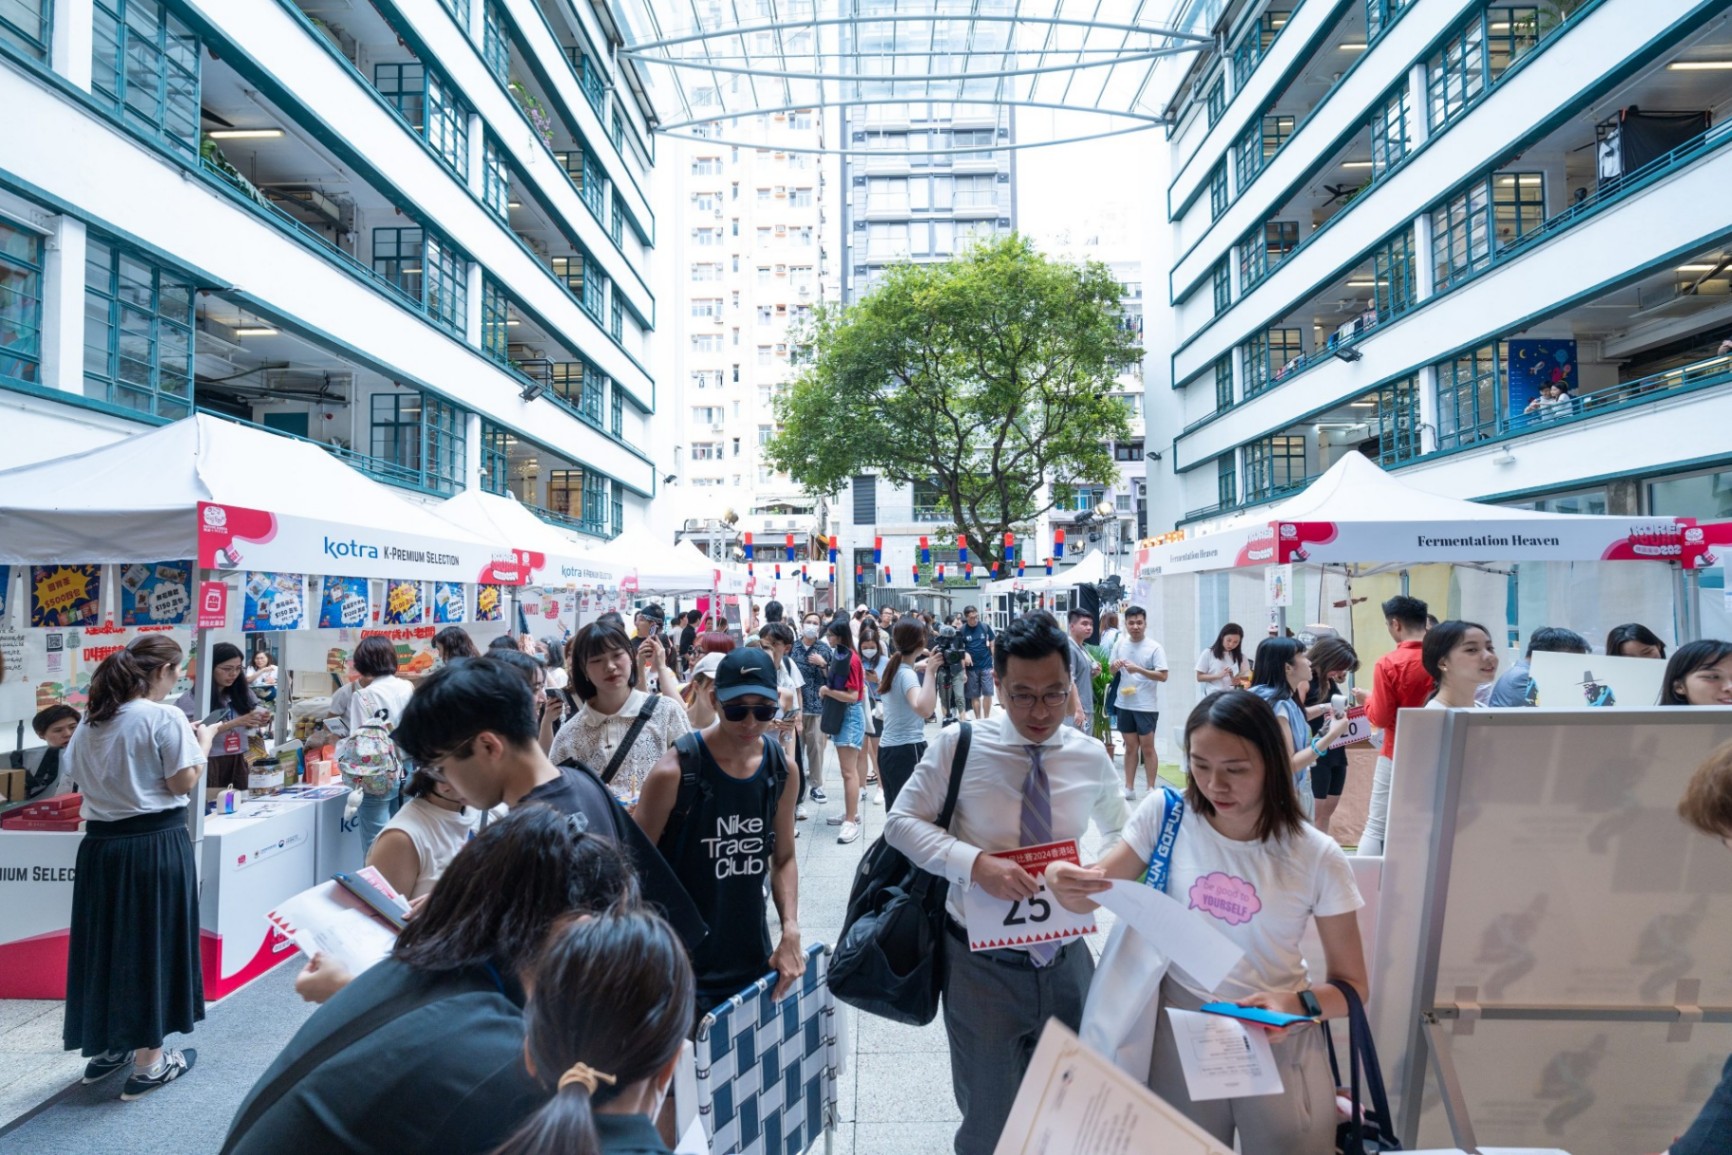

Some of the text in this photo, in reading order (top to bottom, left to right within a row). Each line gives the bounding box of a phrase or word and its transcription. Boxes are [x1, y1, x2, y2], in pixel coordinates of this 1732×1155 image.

[324, 536, 378, 559] kotra
[1417, 534, 1560, 547] Fermentation Heaven
[561, 564, 582, 578] kotra
[716, 814, 764, 837] Nike
[1157, 801, 1184, 858] GOFUN
[715, 855, 764, 879] Club
[1203, 881, 1250, 902] be good to
[1003, 884, 1051, 926] 25
[1203, 894, 1248, 917] YOURSELF
